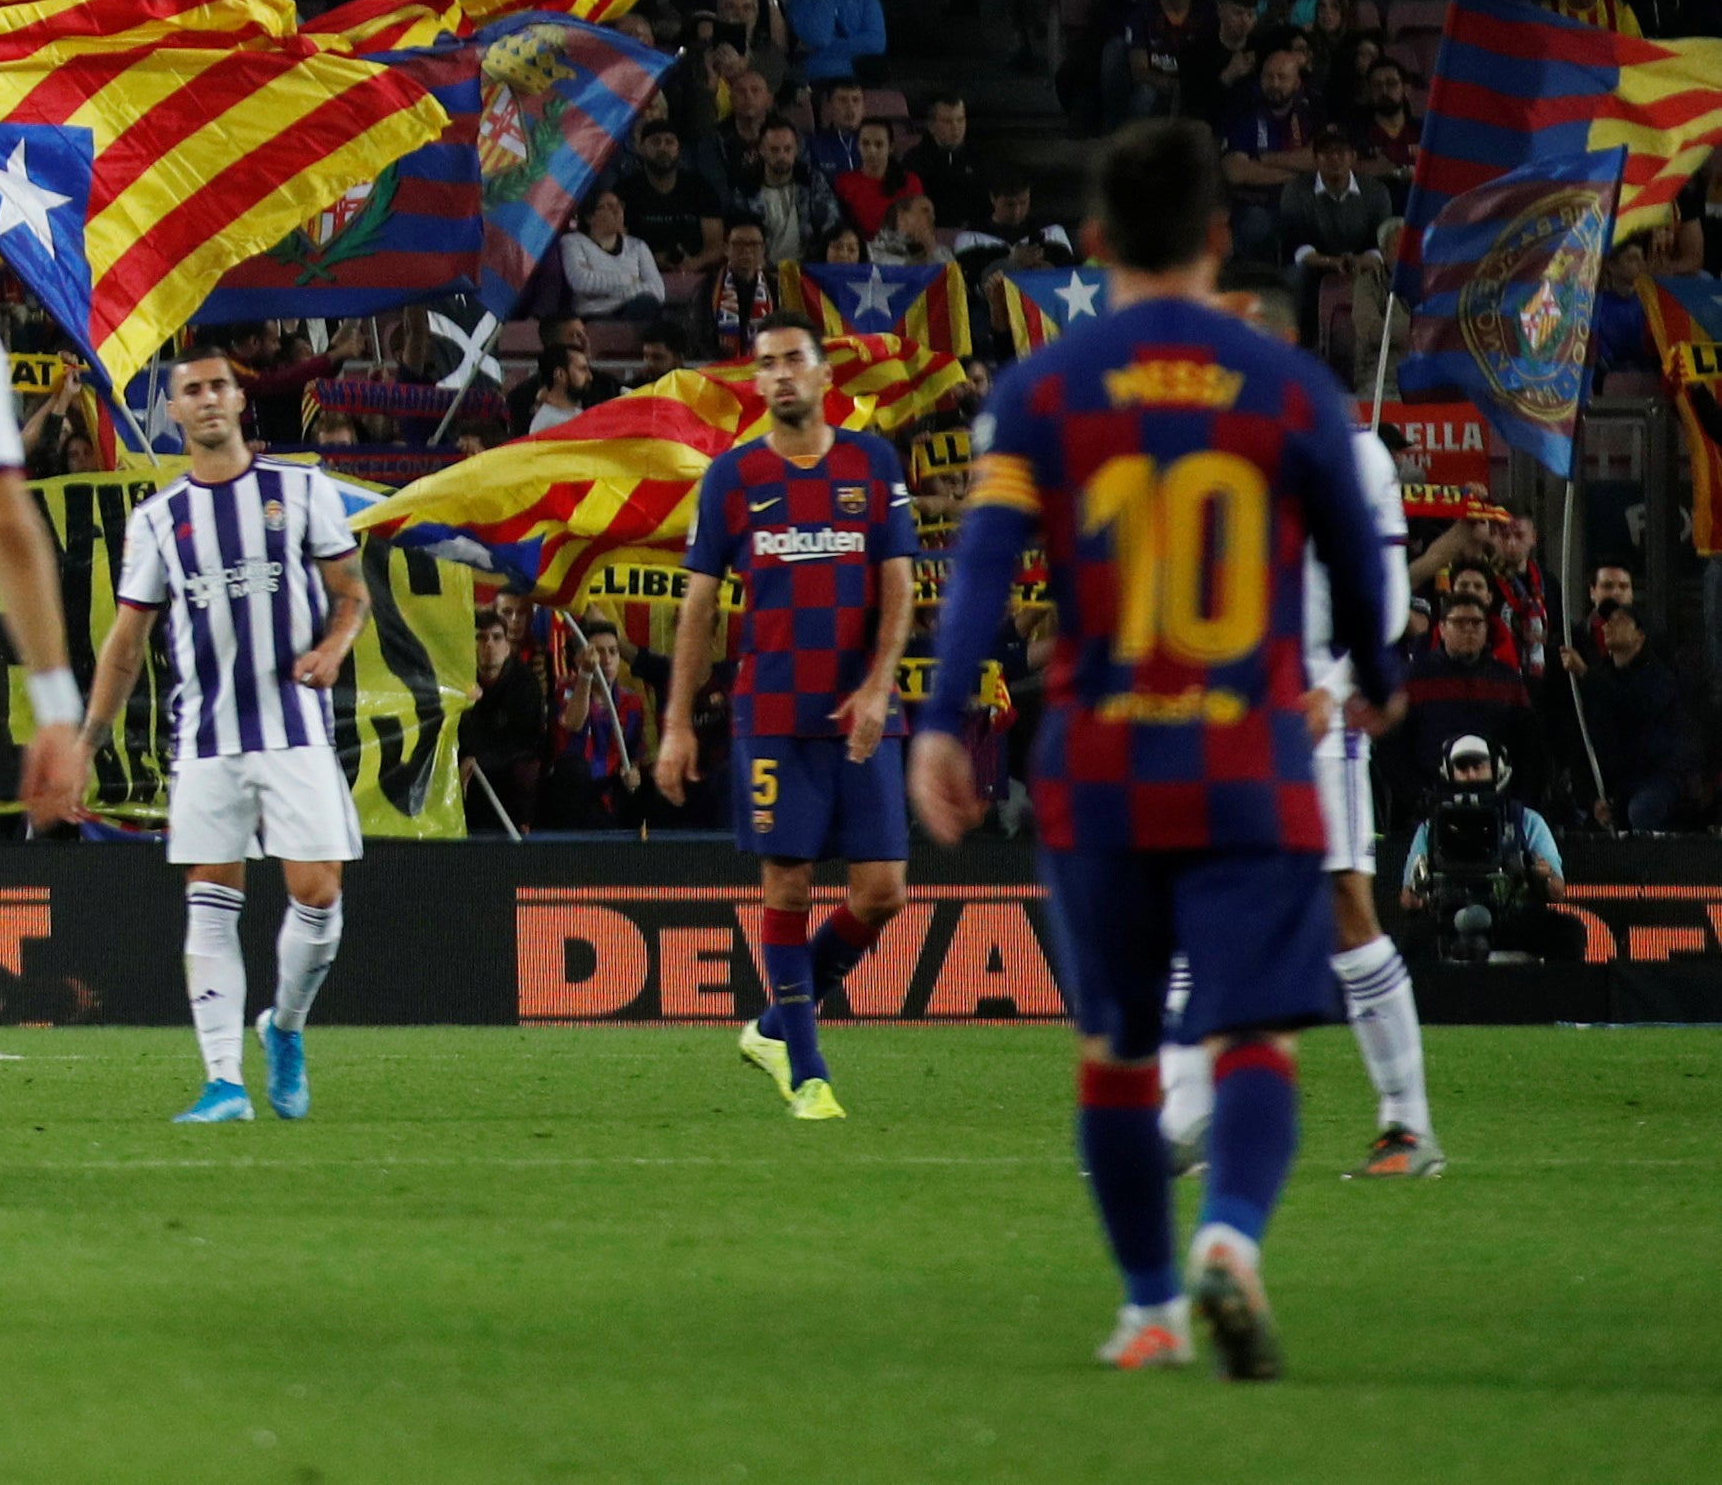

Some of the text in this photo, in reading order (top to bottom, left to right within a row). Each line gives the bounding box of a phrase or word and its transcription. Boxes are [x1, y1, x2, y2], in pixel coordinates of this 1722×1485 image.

[753, 527, 865, 556] Rakuten
[1079, 450, 1269, 667] 10
[750, 758, 779, 806] 5
